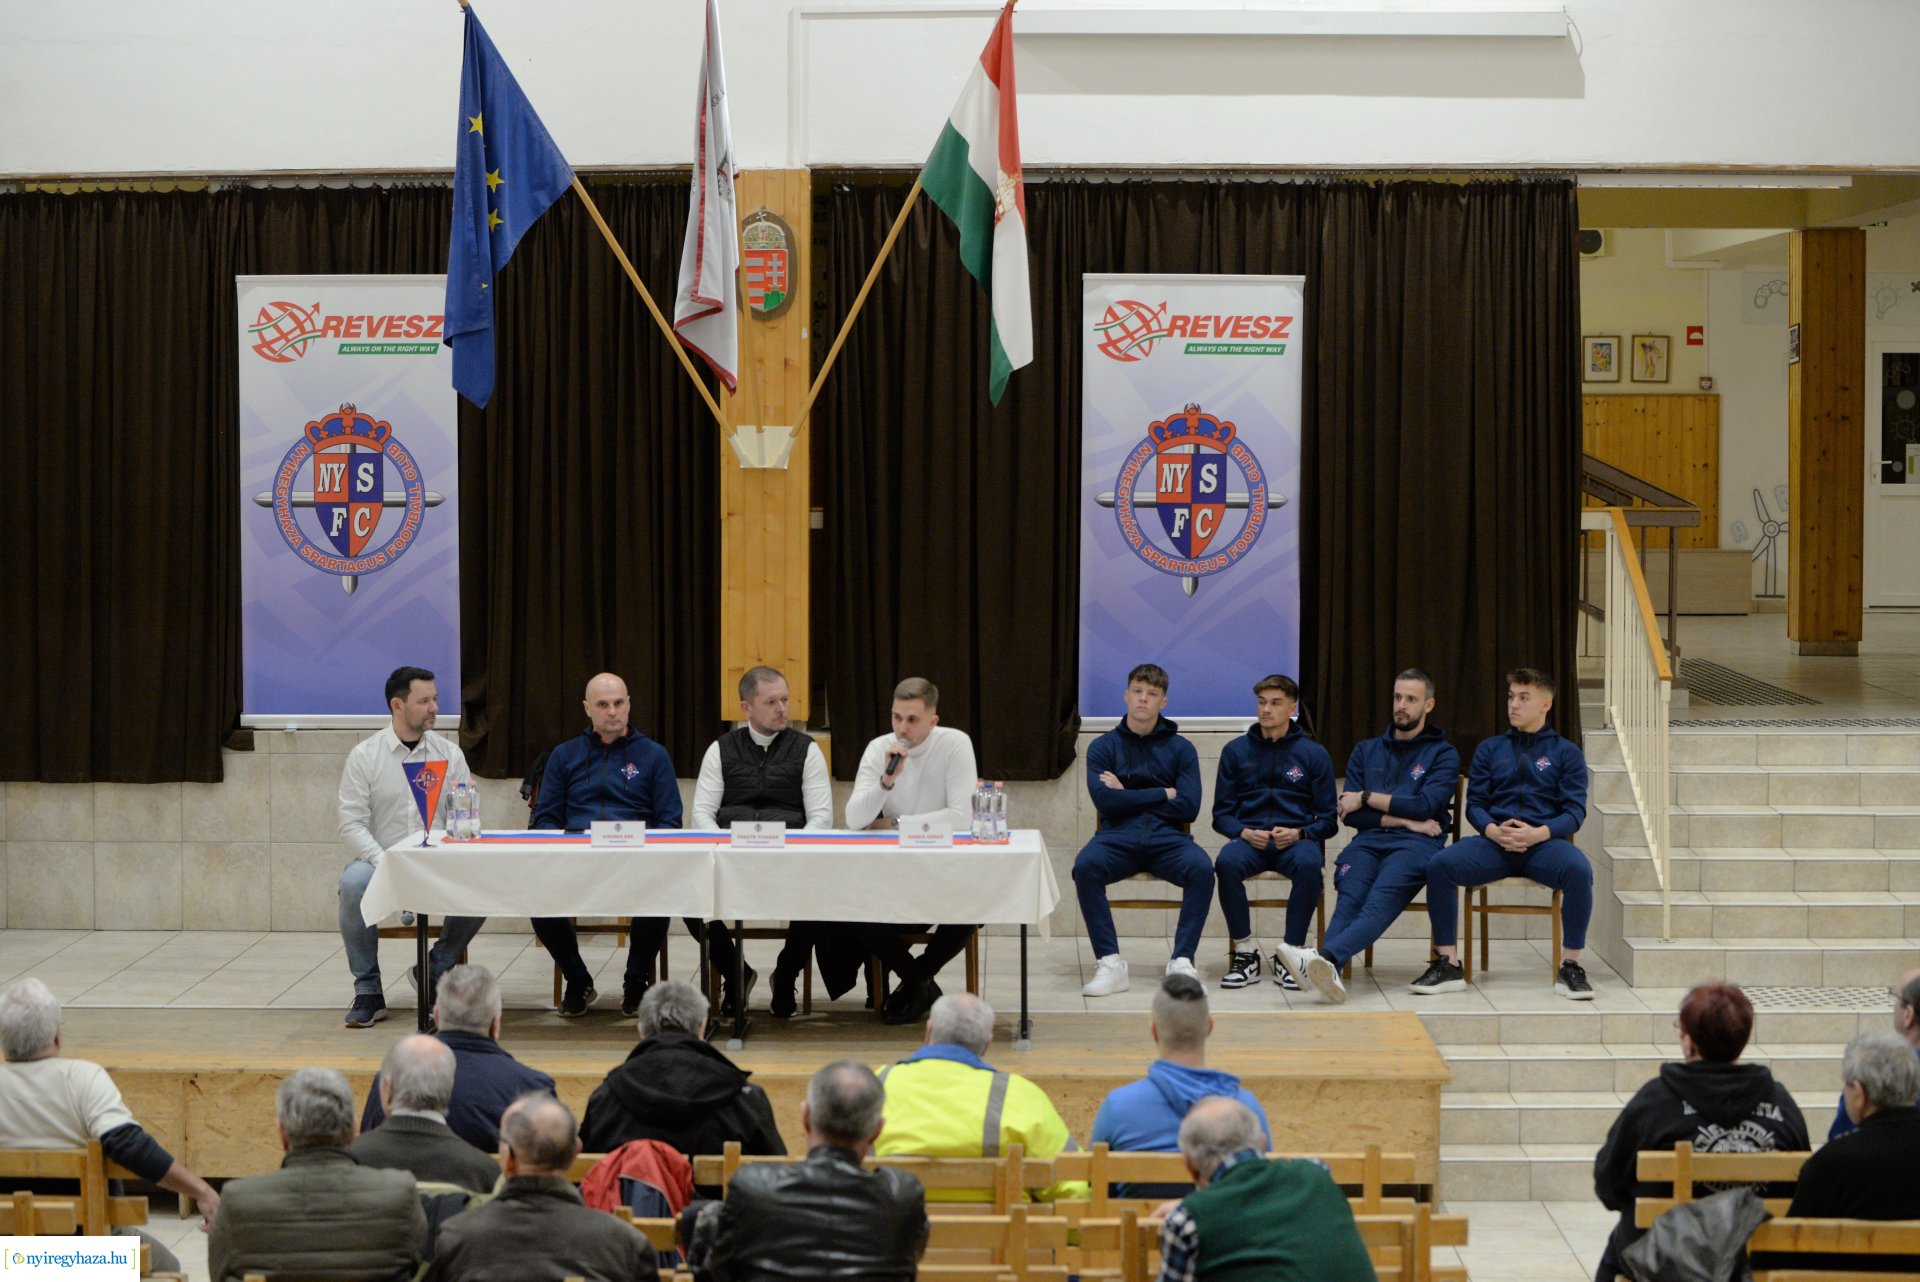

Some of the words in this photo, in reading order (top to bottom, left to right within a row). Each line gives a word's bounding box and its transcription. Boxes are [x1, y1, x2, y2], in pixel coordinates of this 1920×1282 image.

[387, 443, 416, 481] CLUB
[1231, 444, 1260, 482] CLUB
[317, 463, 346, 493] NY
[356, 463, 376, 493] S
[1160, 463, 1190, 493] NY
[1199, 463, 1218, 494] S
[329, 507, 348, 537] F
[353, 507, 372, 538] C
[386, 483, 421, 558] FOOTBALL
[1171, 508, 1190, 538] F
[1195, 508, 1214, 539] C
[1228, 484, 1264, 559] FOOTBALL
[301, 545, 387, 573] SPARTACUS
[1142, 545, 1228, 574] SPARTACUS
